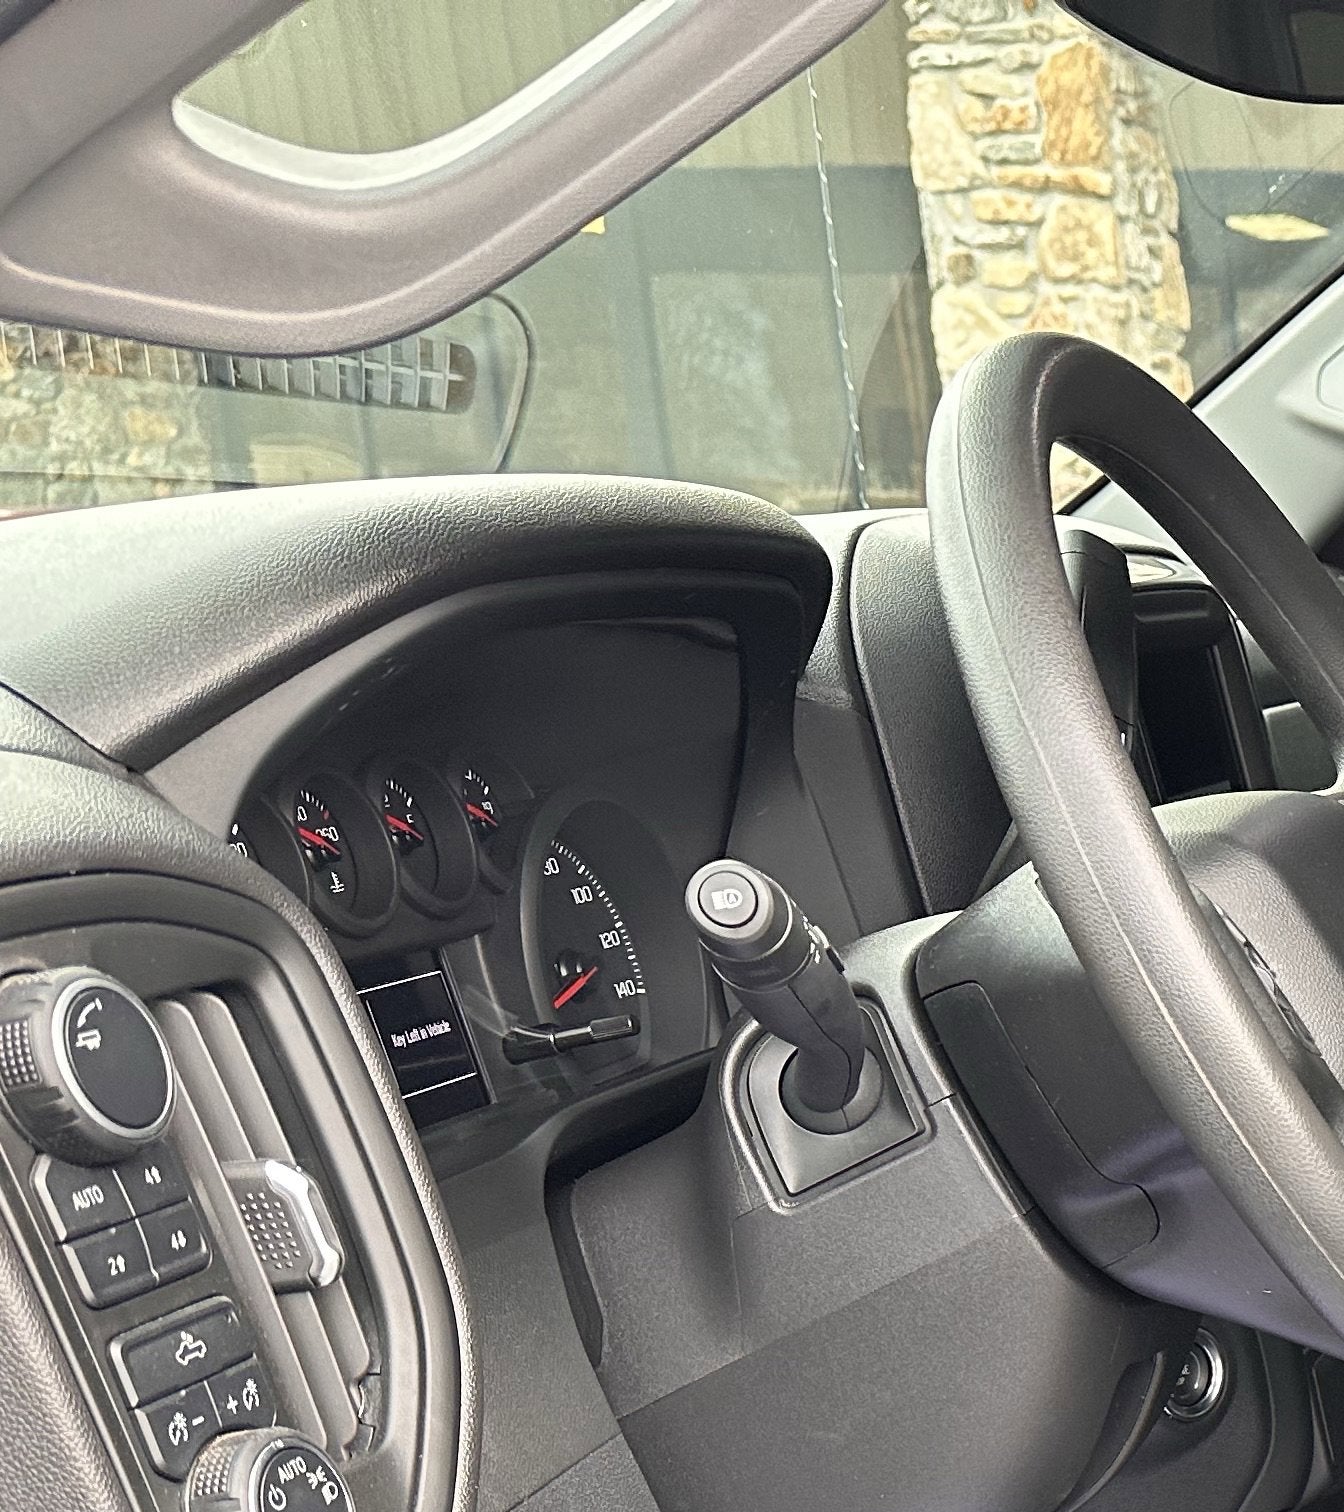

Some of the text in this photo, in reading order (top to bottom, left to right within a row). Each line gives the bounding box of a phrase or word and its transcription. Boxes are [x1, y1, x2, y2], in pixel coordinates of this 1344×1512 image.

[570, 885, 593, 905] 100
[599, 930, 621, 950] 120
[613, 979, 636, 999] 140
[391, 1033, 407, 1049] Key
[72, 1184, 105, 1211] AUTO
[277, 1455, 307, 1484] AUTO
